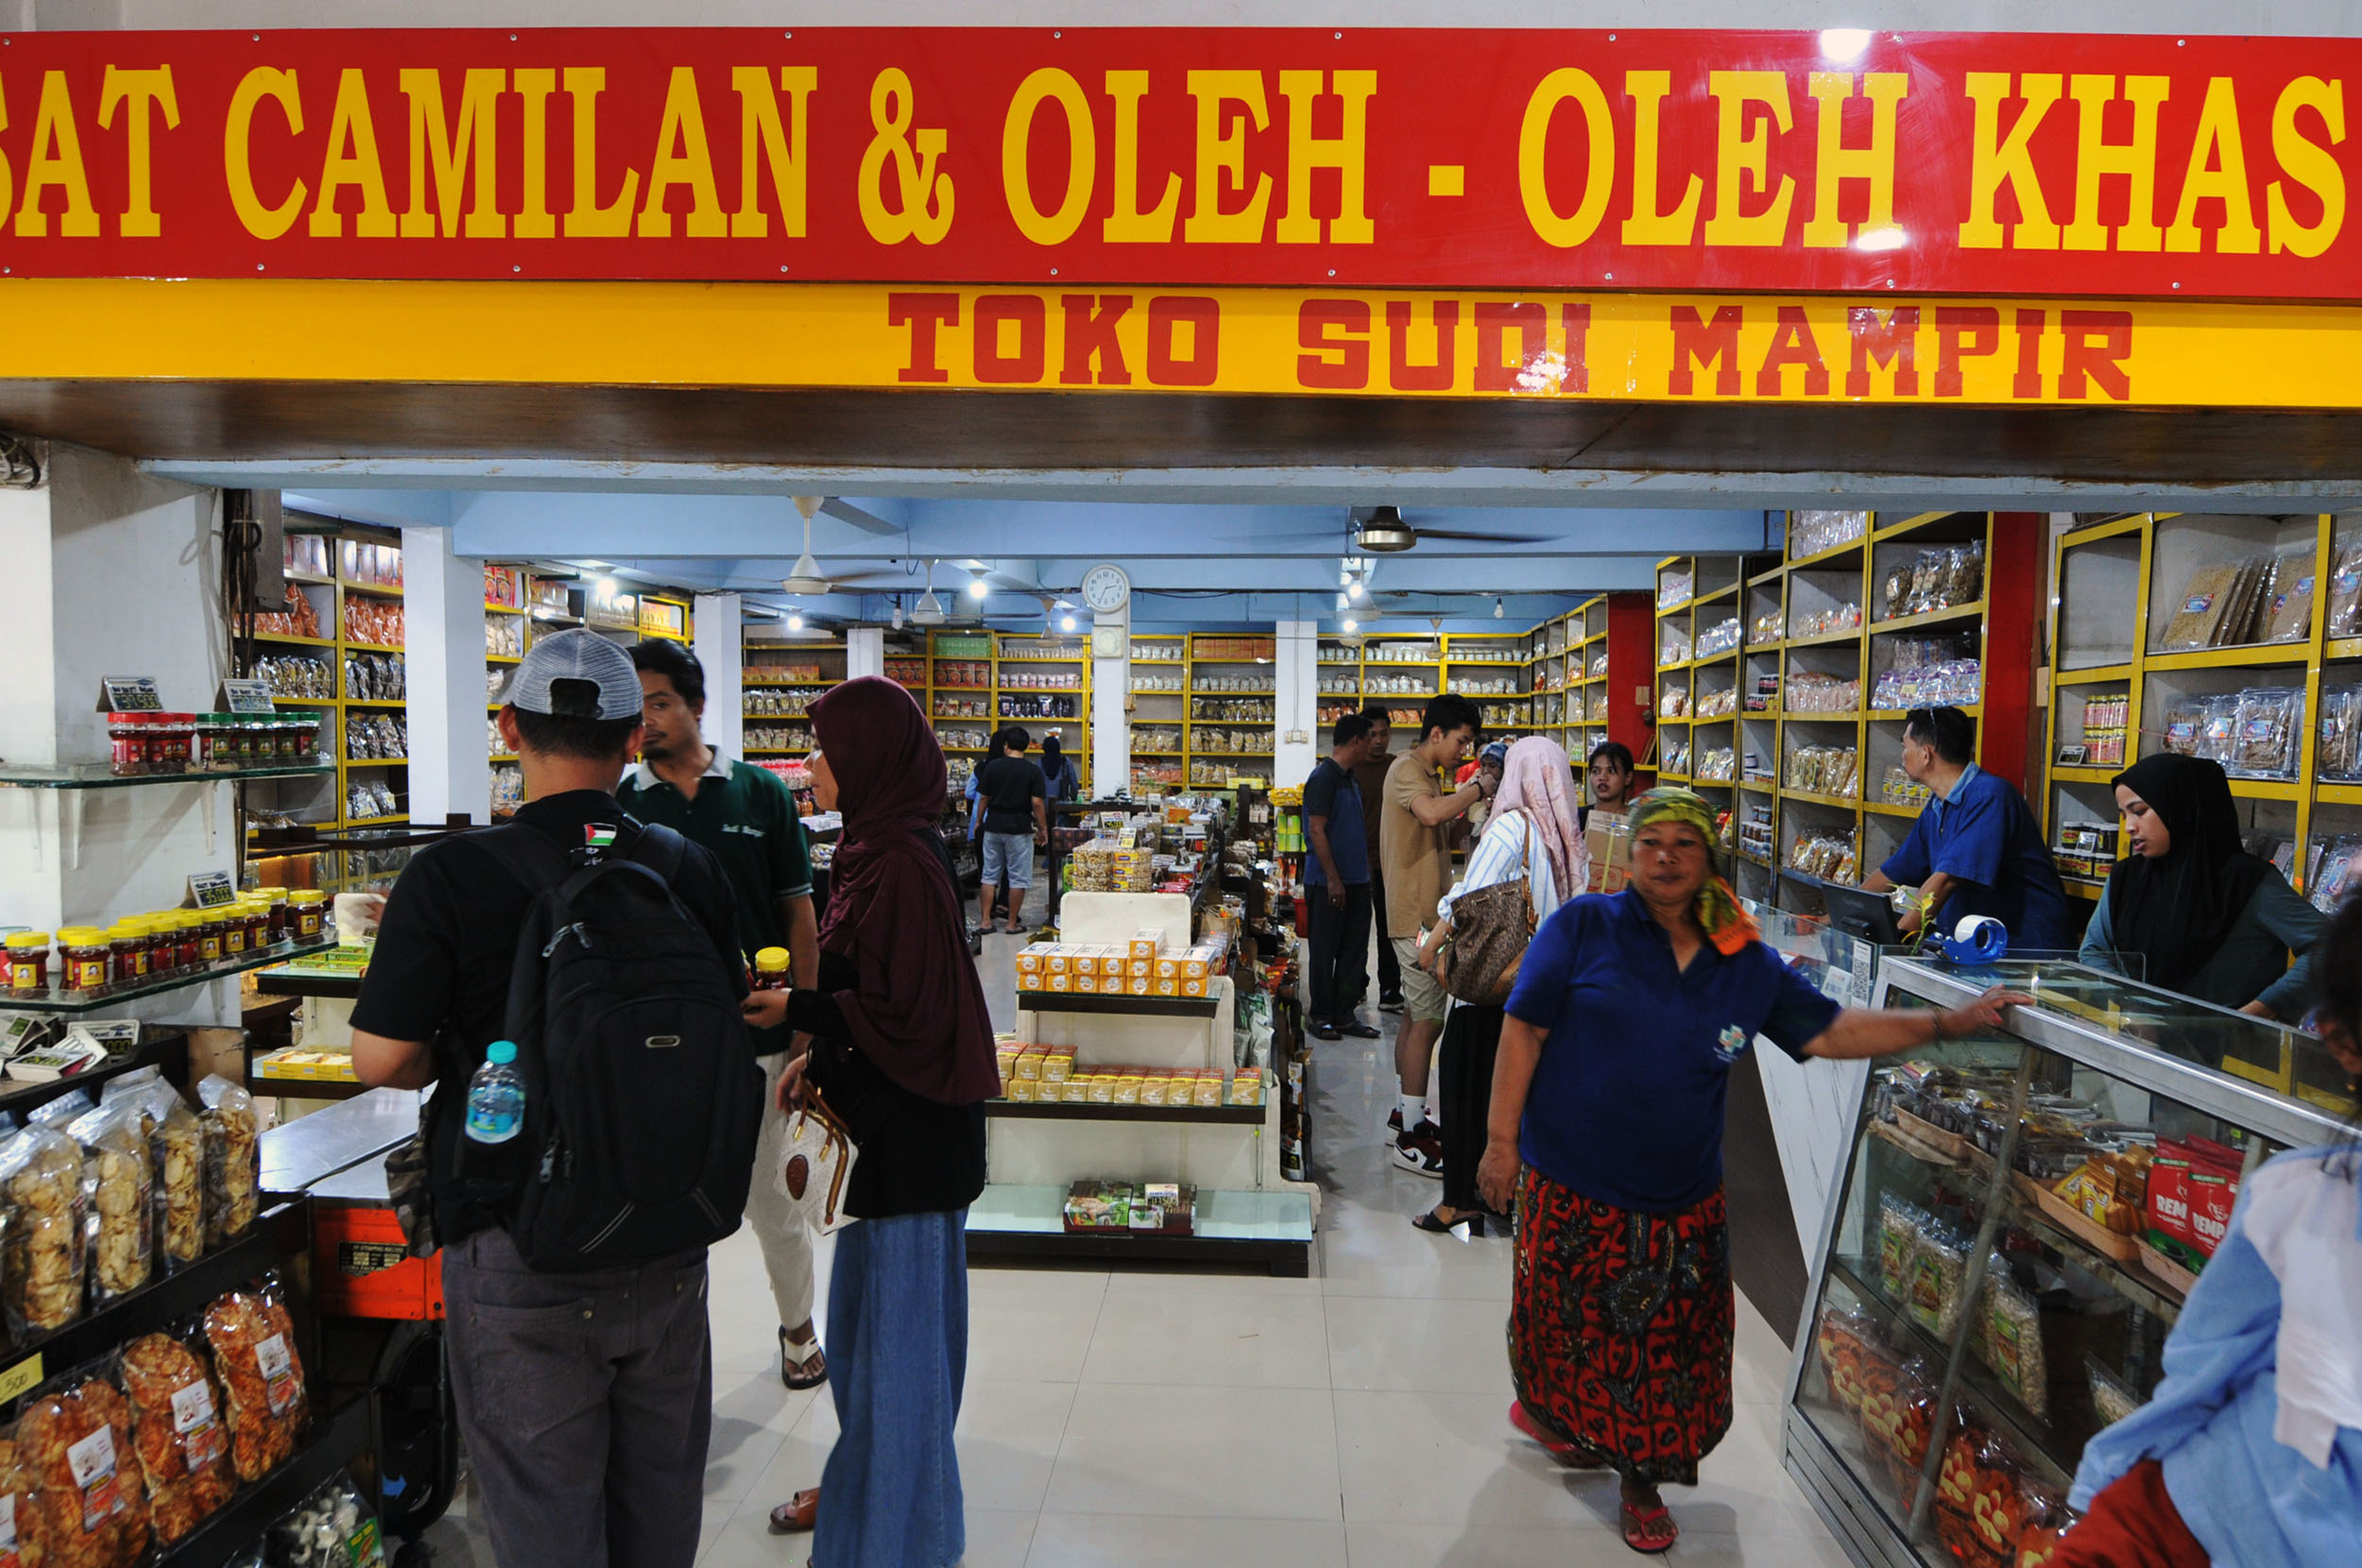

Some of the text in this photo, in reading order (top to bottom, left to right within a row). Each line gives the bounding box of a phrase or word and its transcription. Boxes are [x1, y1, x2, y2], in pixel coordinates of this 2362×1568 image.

[0, 64, 180, 237] AT
[225, 66, 817, 240] CAMILAN
[858, 67, 955, 246] &
[1001, 67, 1378, 246] OLEH
[1518, 67, 1909, 248] OLEH
[1958, 72, 2346, 258] KHAS
[888, 293, 2134, 401] TOKO SUDI MAMPIR
